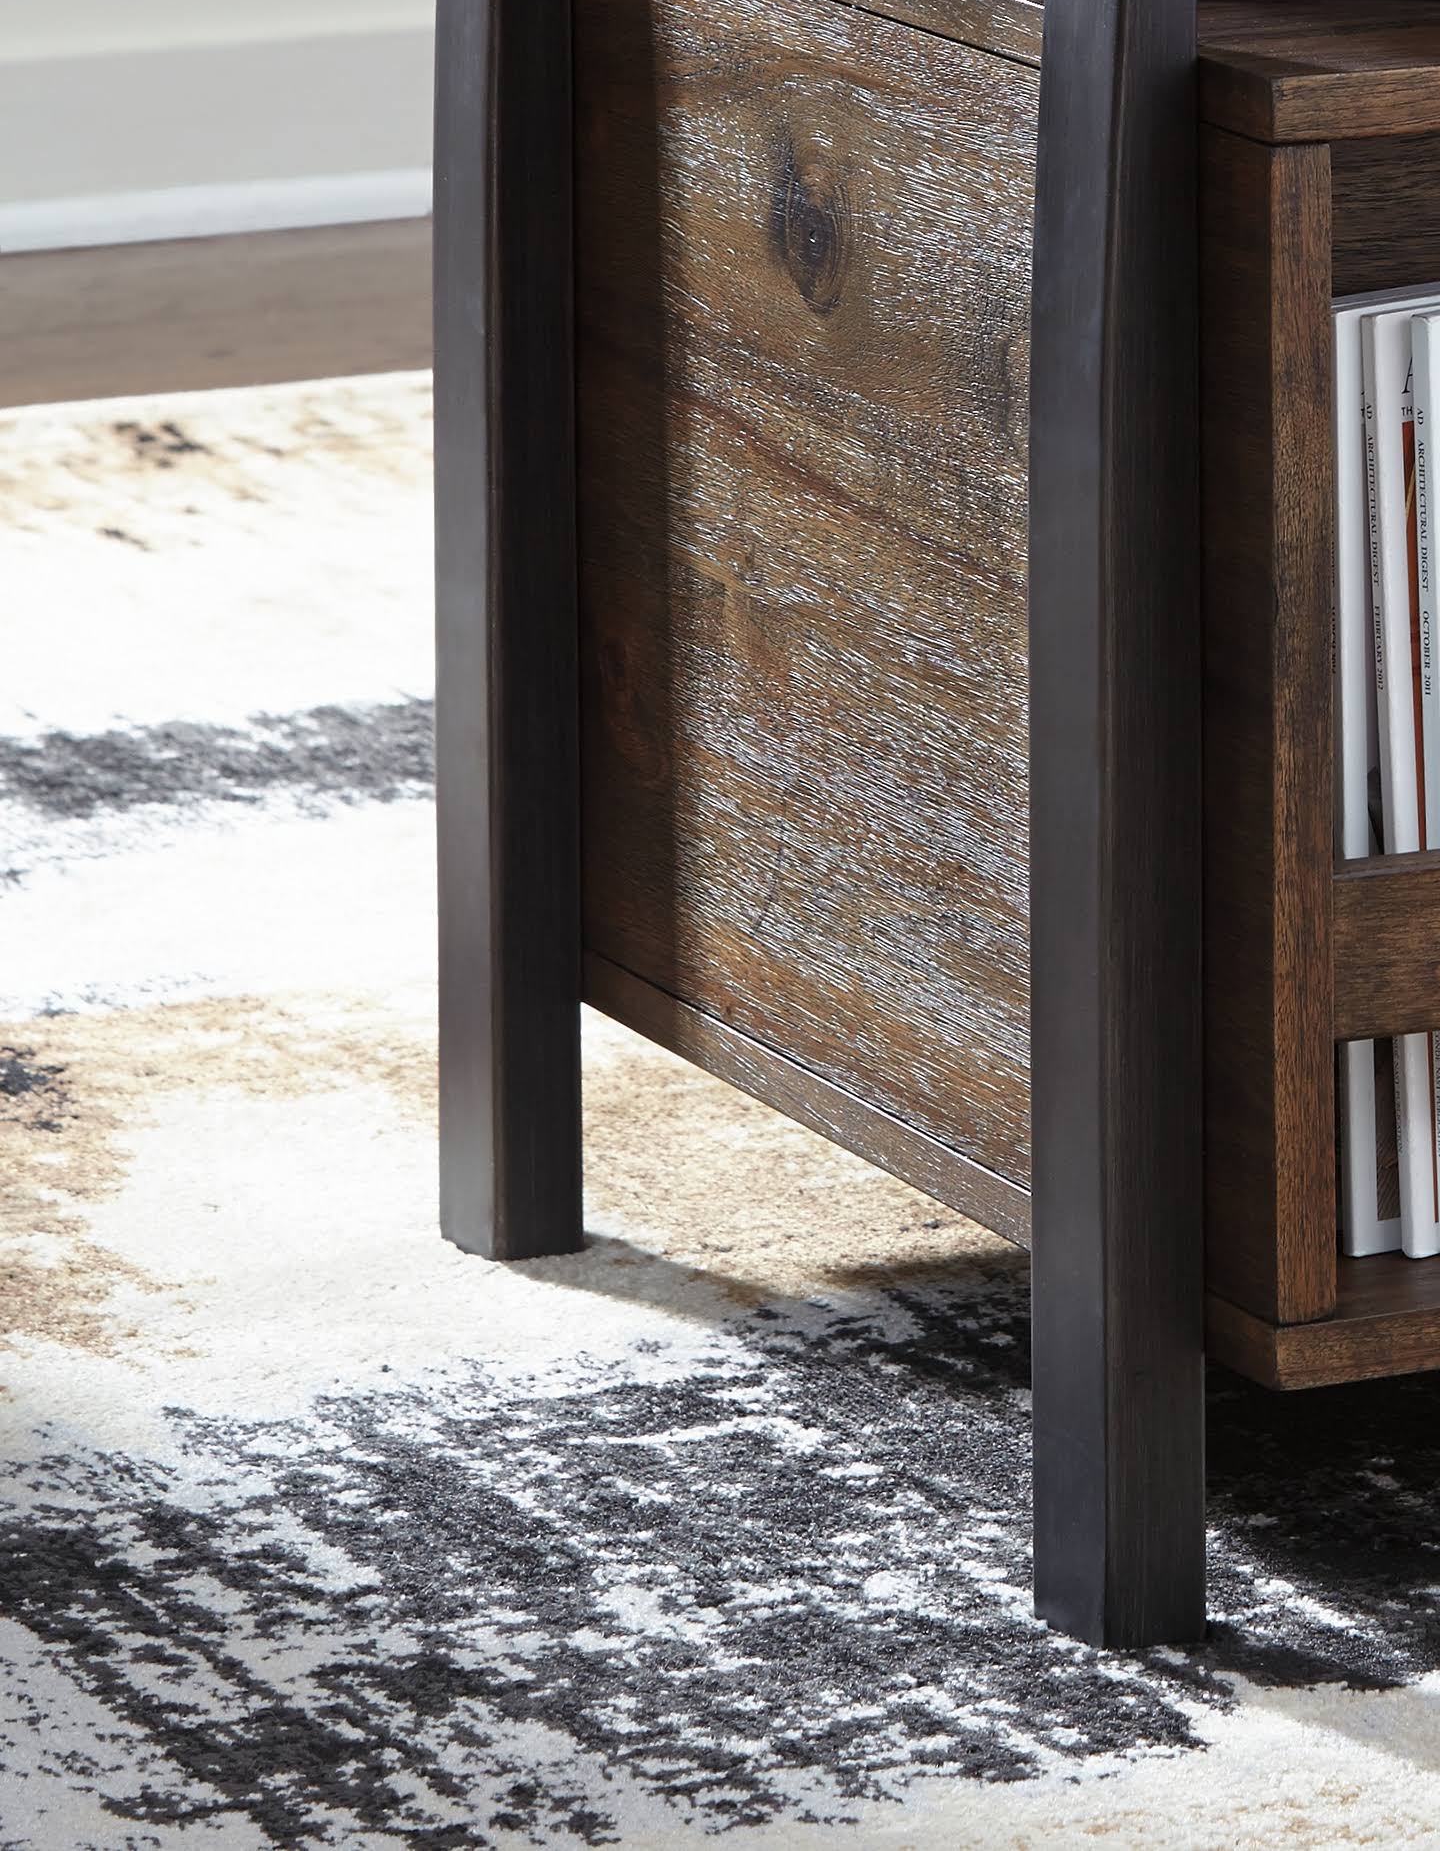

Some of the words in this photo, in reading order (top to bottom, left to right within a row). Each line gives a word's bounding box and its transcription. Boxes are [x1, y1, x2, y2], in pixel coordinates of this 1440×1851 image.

[1366, 403, 1373, 420] AD
[1416, 408, 1423, 425] AD
[1367, 434, 1377, 534] ARCHITECTURAL
[1418, 439, 1429, 543] ARCHITECTURAL
[1372, 541, 1380, 586] DIGEST
[1421, 548, 1430, 591] DIGEST
[1375, 605, 1383, 665] FEBRUARY
[1423, 610, 1431, 669] OCTOBER
